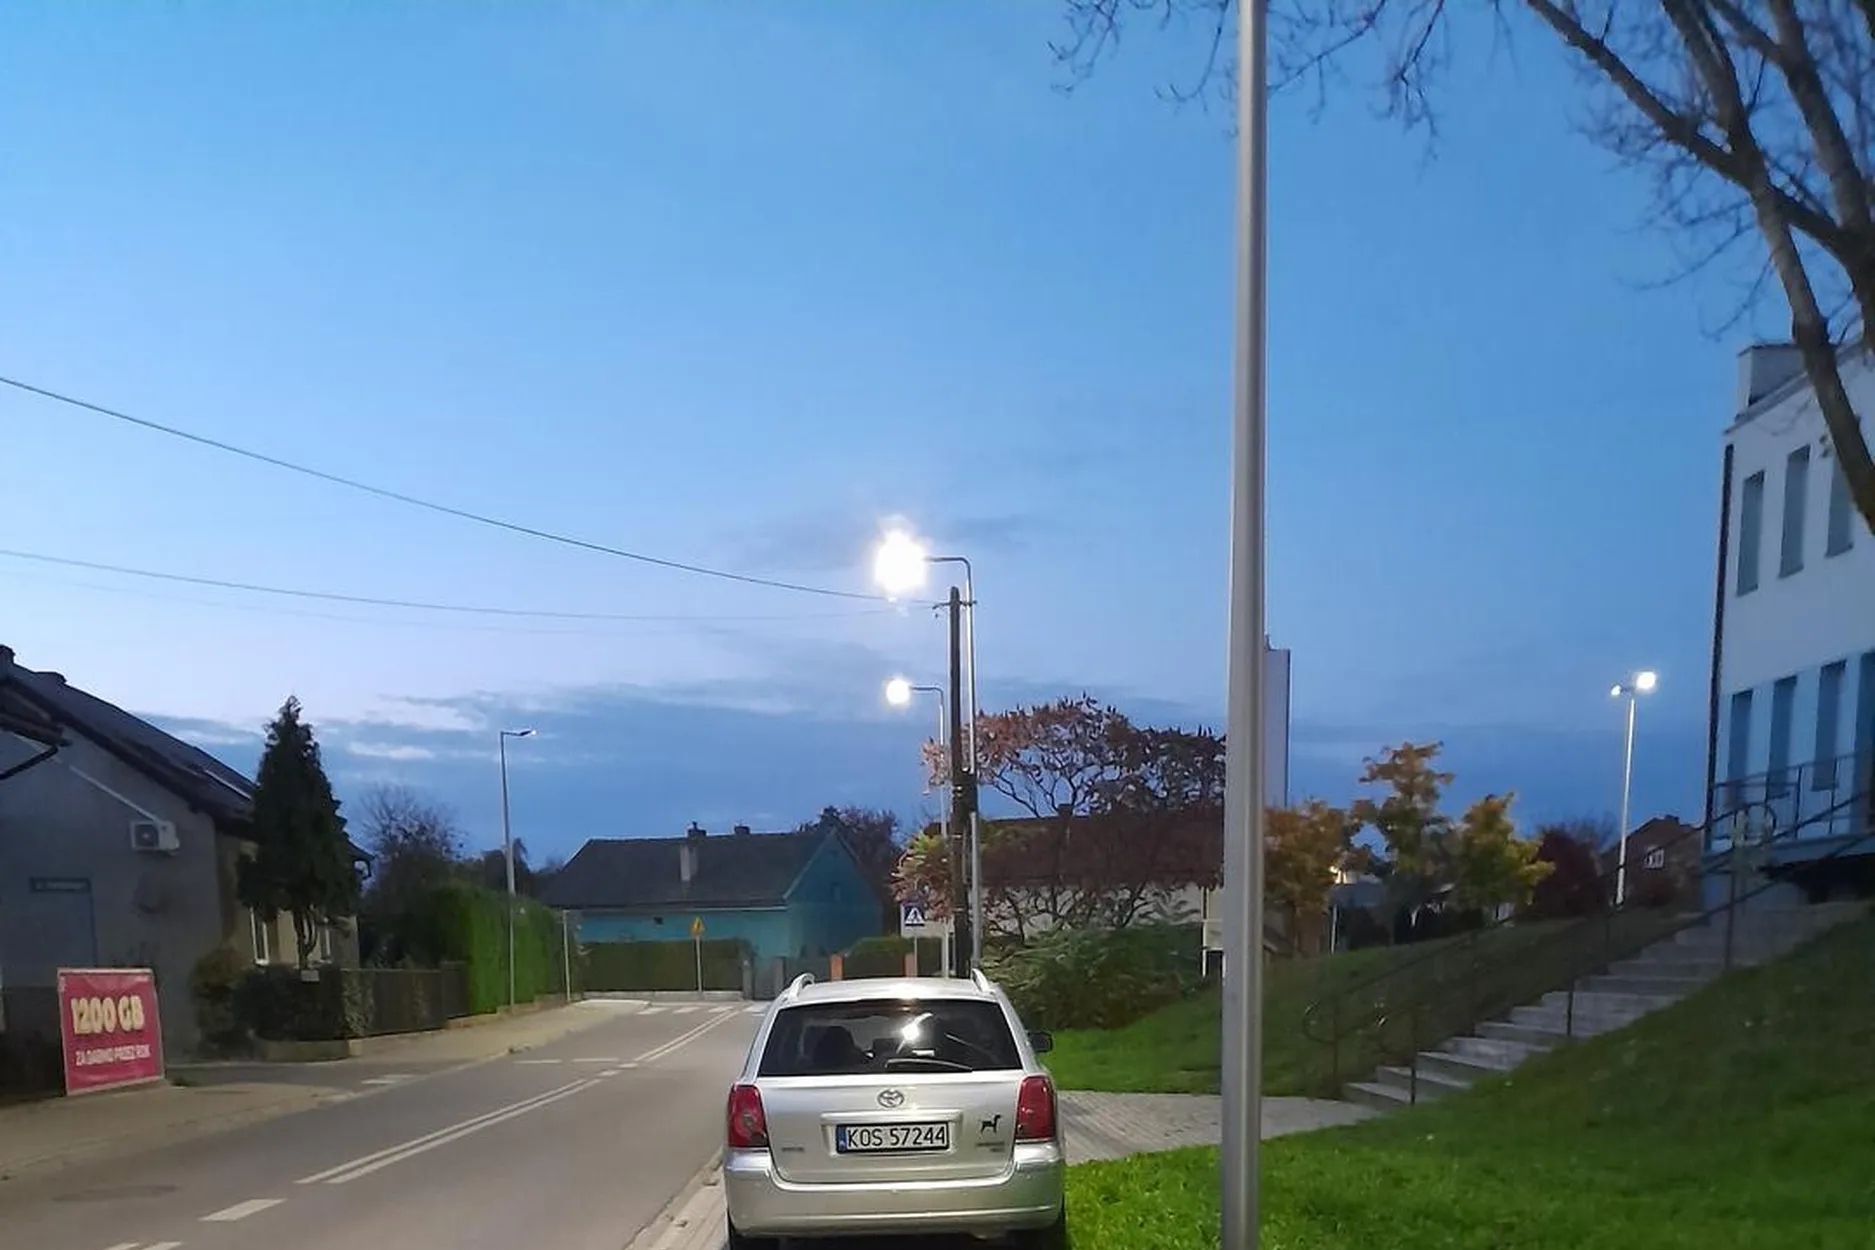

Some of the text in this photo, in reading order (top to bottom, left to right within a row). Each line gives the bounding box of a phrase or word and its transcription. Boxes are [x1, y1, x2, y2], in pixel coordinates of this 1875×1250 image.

[71, 995, 145, 1034] 1200 GB
[847, 1126, 945, 1147] KOS 57244
